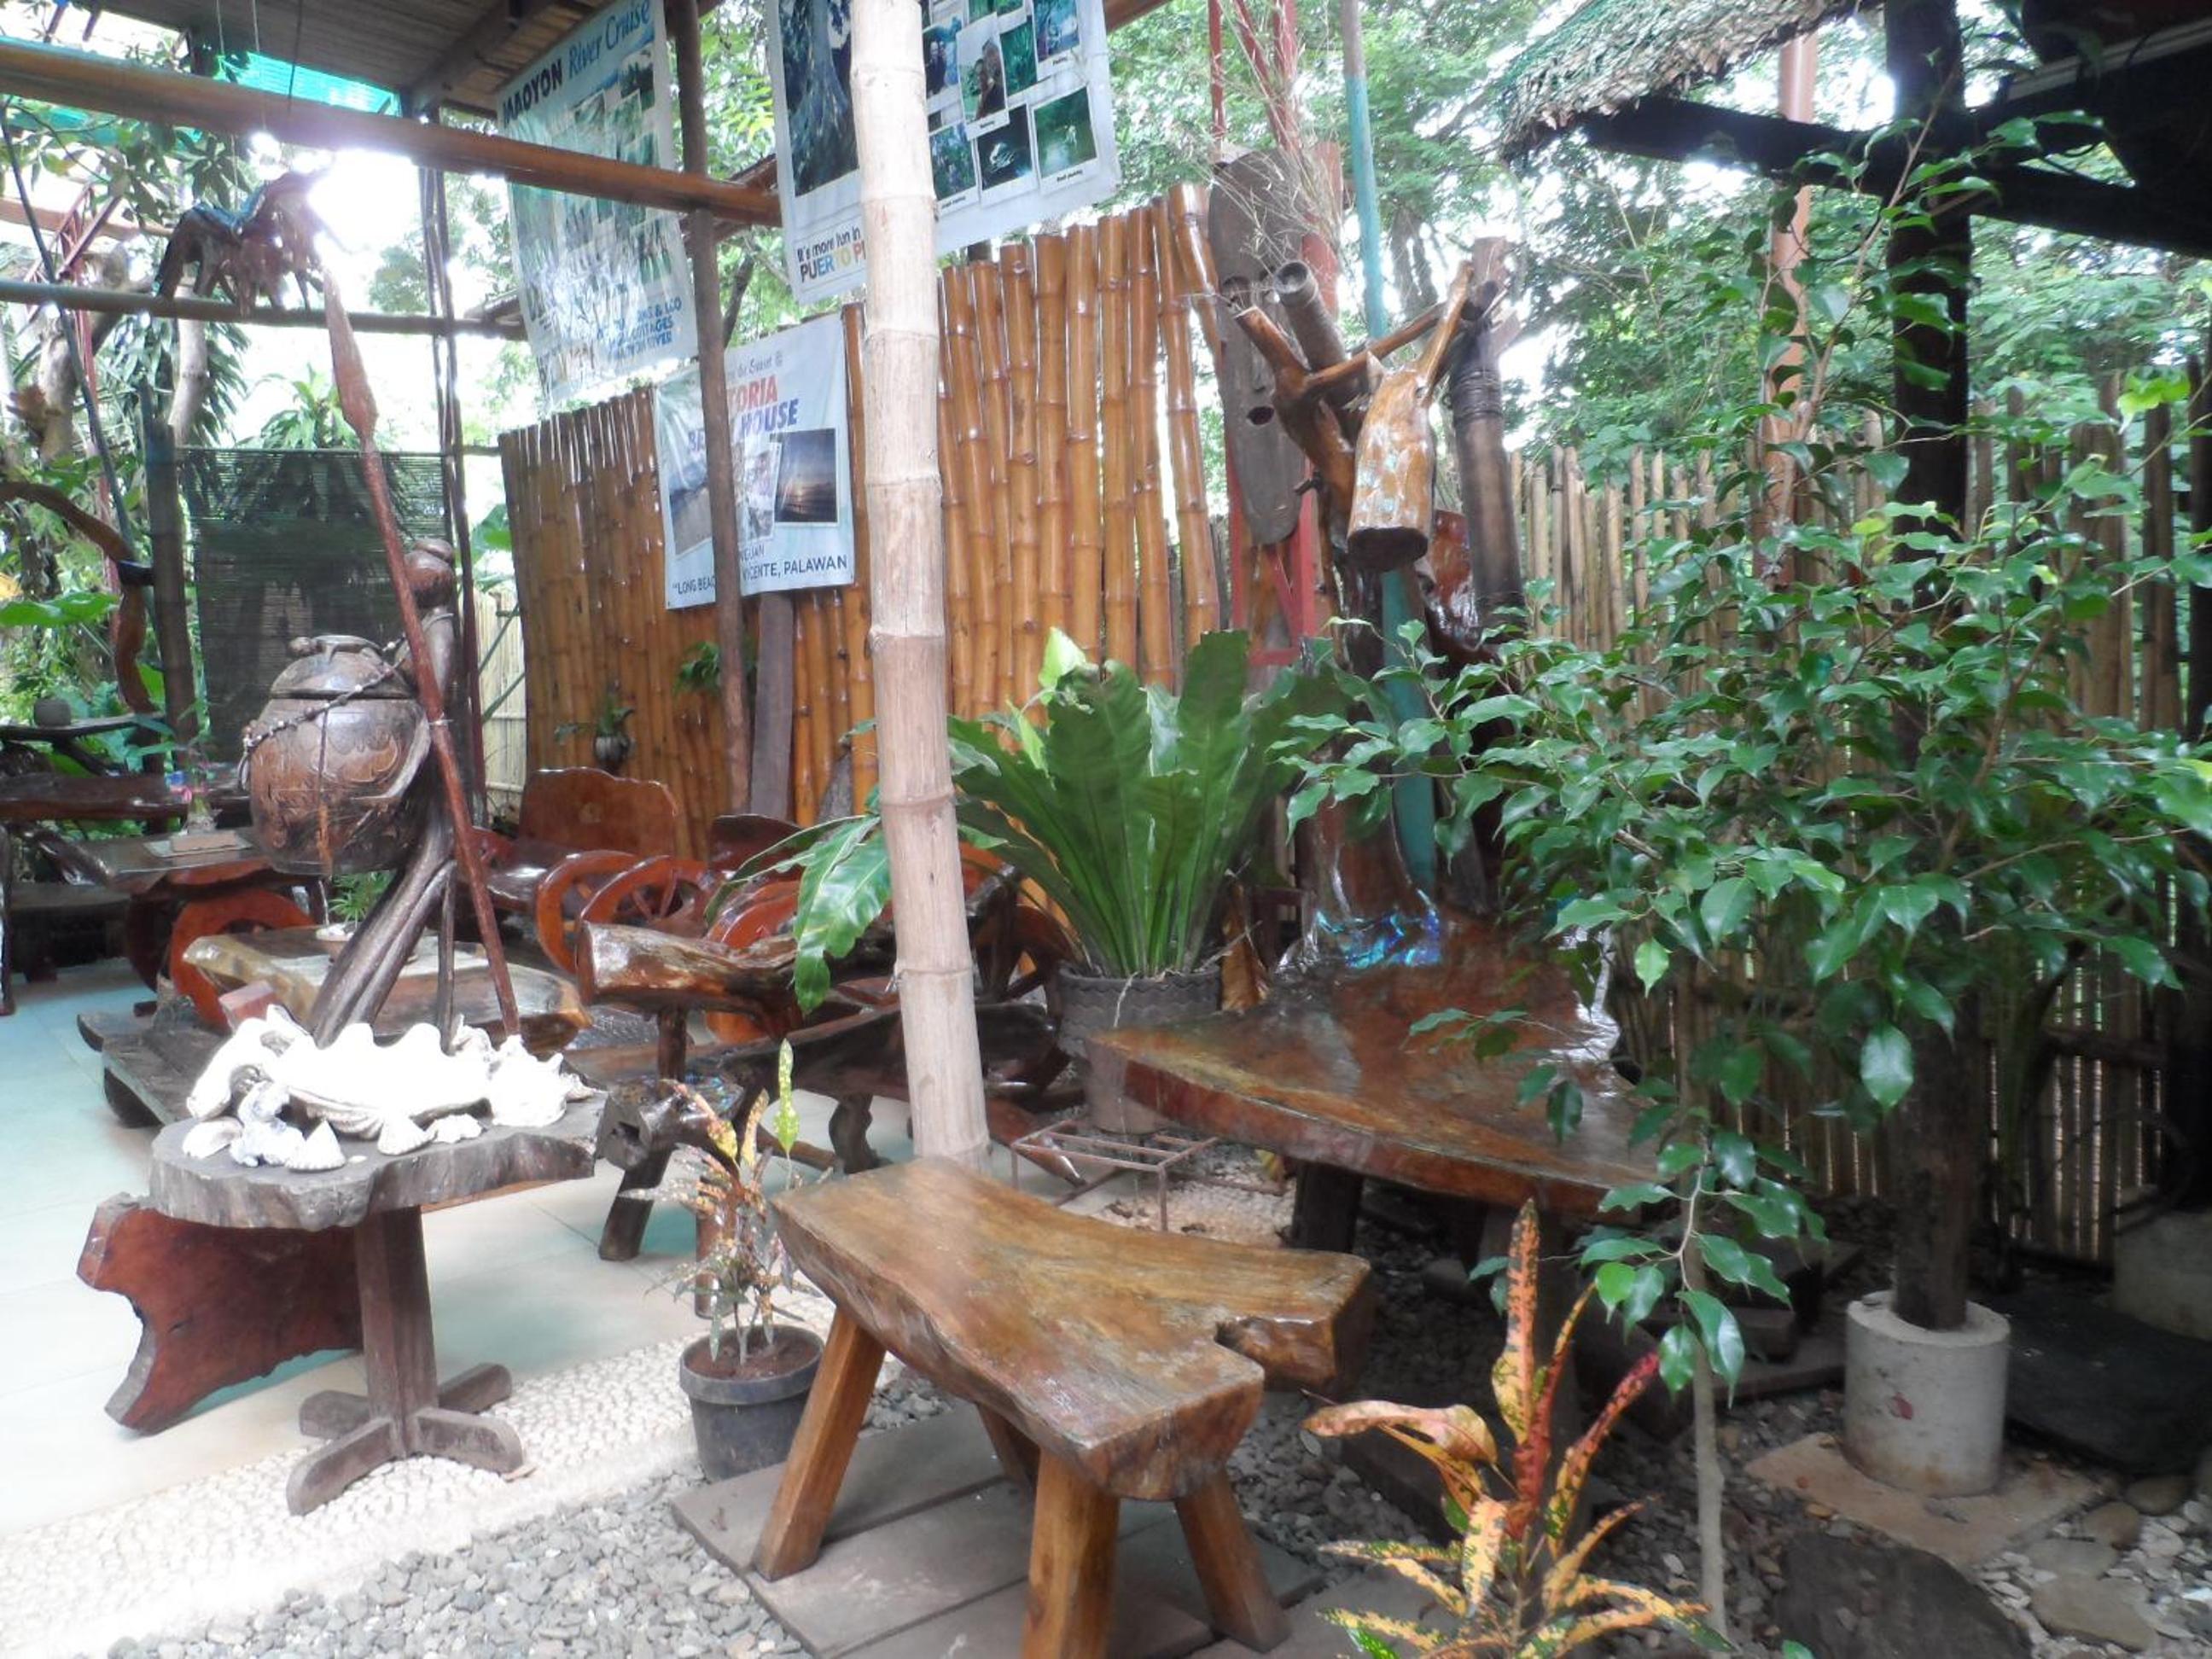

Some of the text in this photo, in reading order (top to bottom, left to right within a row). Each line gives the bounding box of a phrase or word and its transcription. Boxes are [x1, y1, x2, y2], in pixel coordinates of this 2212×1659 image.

[568, 37, 602, 79] River
[605, 1, 650, 50] Cruise
[800, 247, 851, 283] PUERTO
[812, 238, 834, 257] more
[726, 374, 778, 411] TORIA
[741, 399, 800, 437] HOUSE
[698, 576, 716, 591] BEAC
[783, 555, 847, 575] PALAWAN
